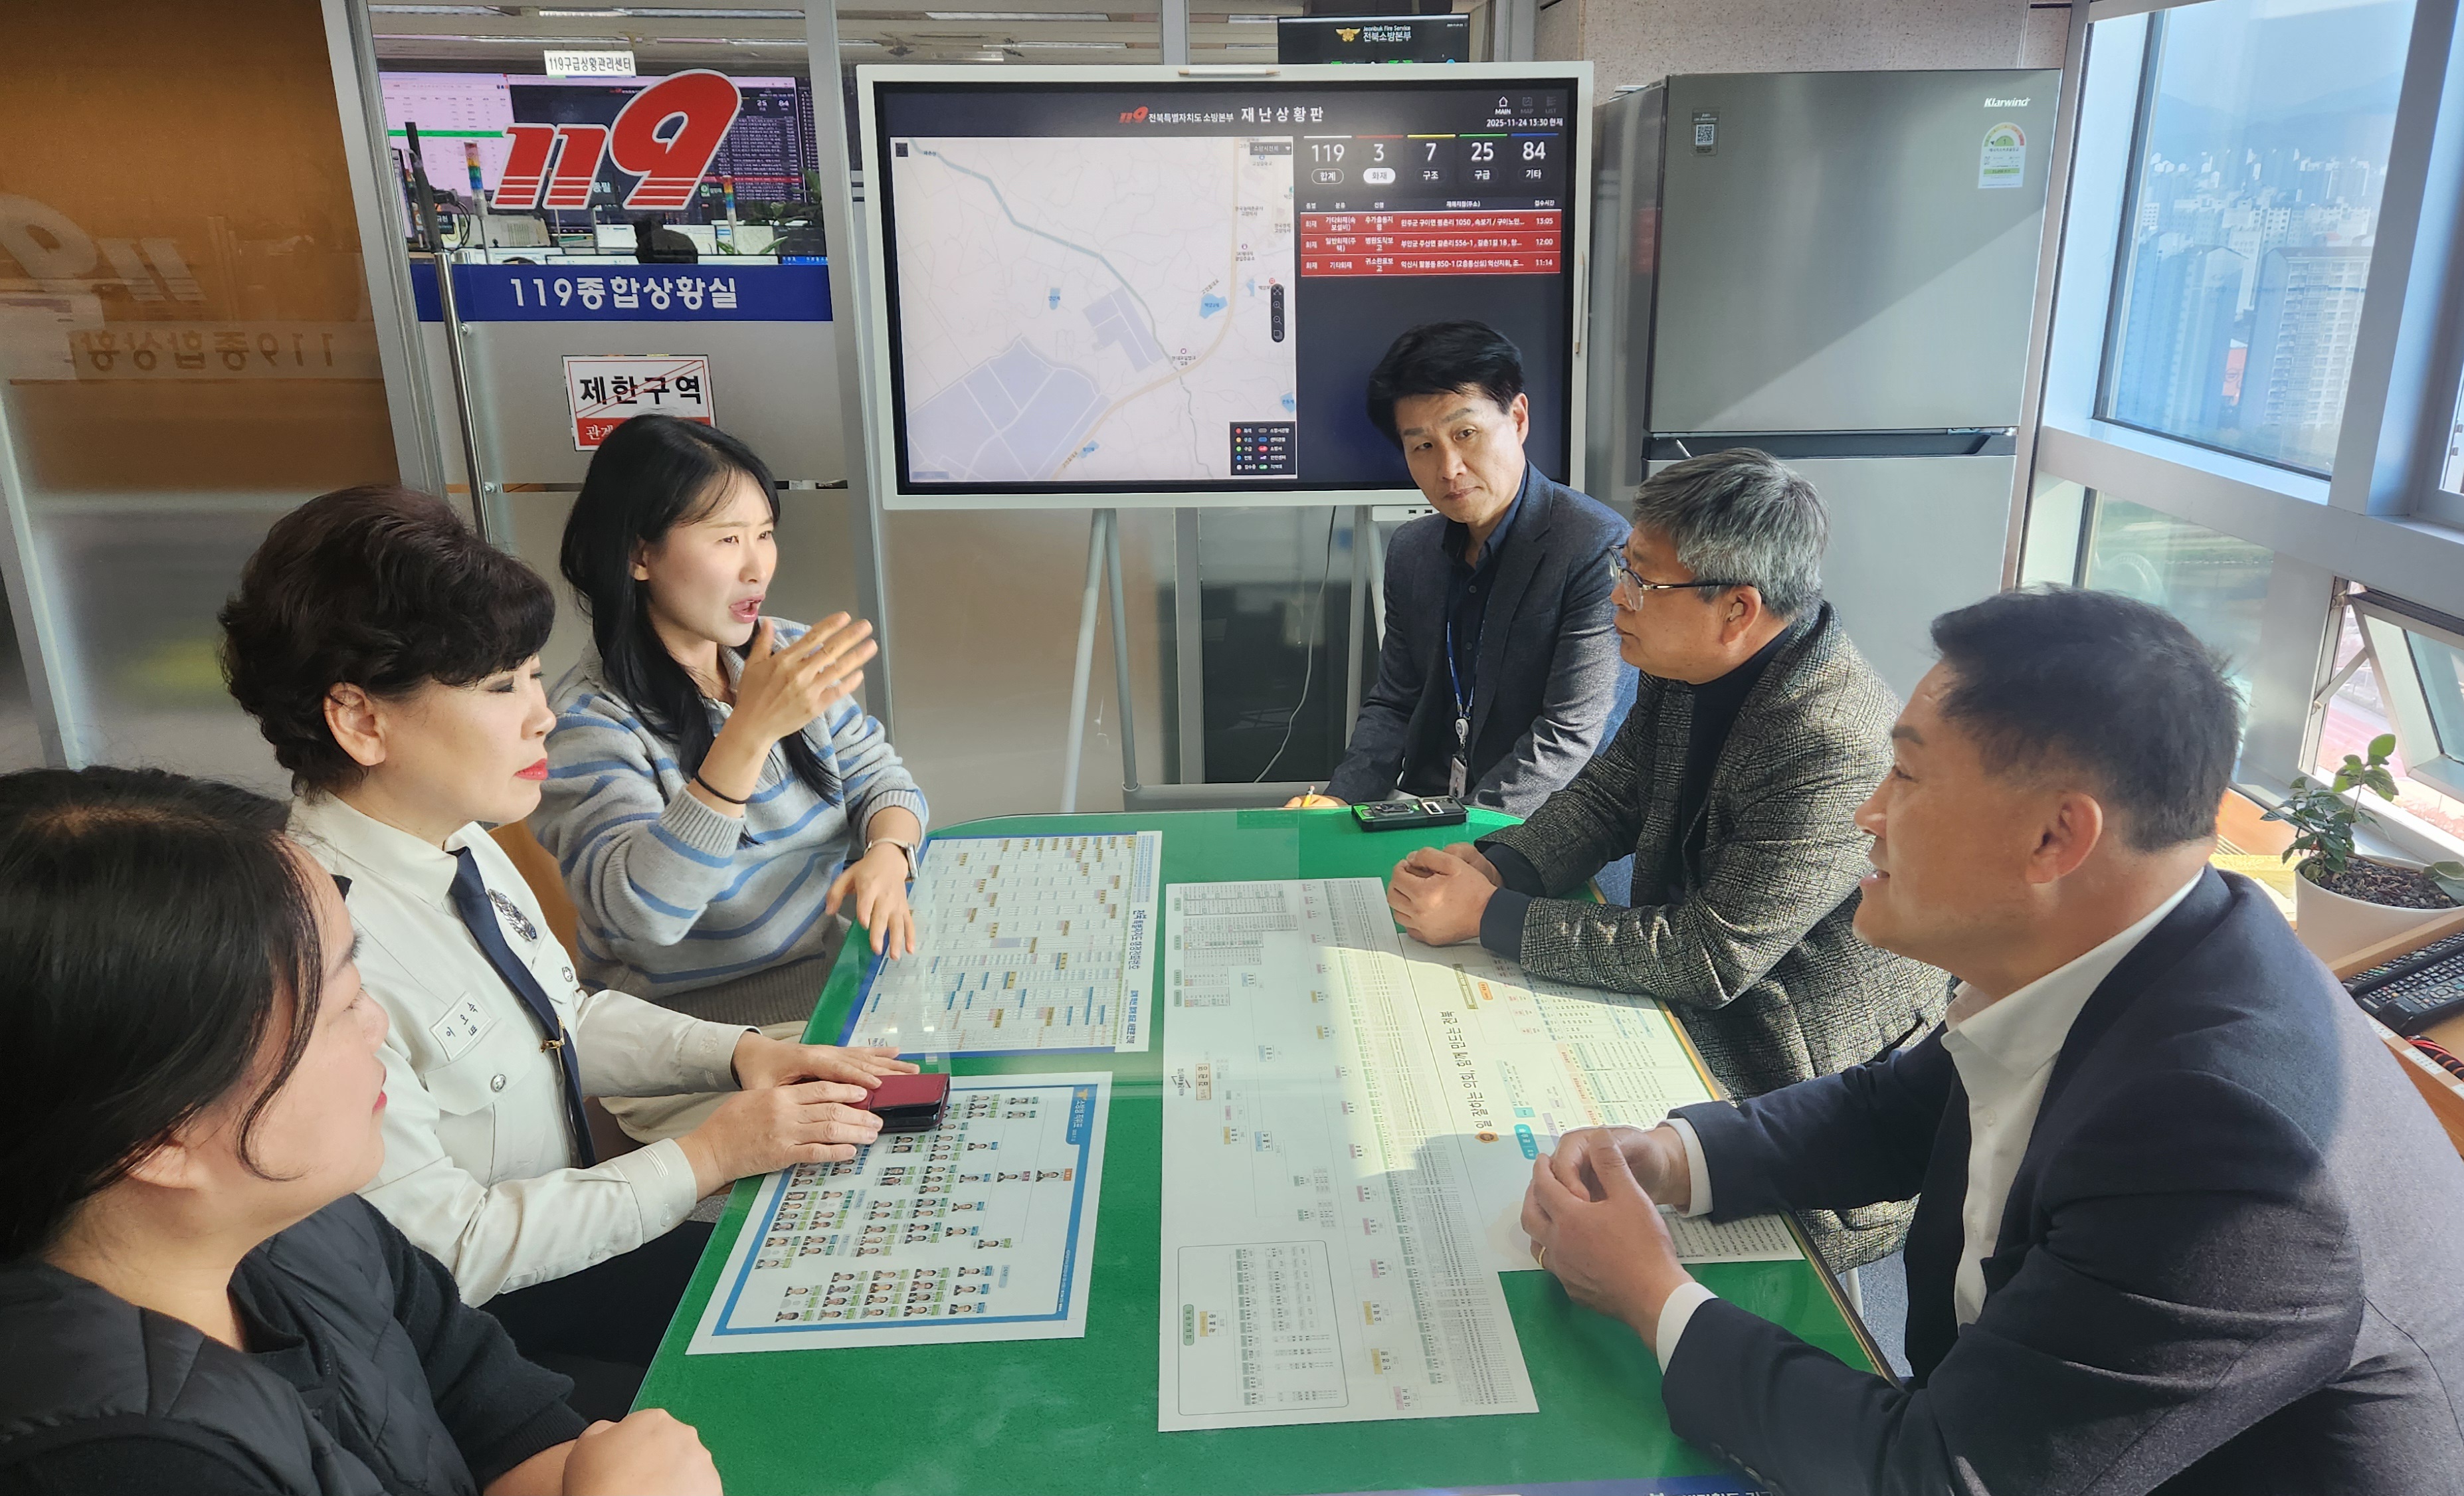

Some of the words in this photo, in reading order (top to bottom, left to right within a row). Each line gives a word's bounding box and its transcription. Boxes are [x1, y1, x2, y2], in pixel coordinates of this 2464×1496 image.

[1363, 31, 1411, 42] 전북소방본부
[549, 55, 631, 72] 119구급상황관리센터
[1119, 106, 1148, 123] 119
[1149, 113, 1202, 122] 전북특별자치도
[1204, 113, 1234, 122] 소방본부
[1486, 118, 1527, 127] 2025-11-24
[1529, 118, 1548, 126] 13:30
[1549, 117, 1563, 127] 현재
[490, 68, 742, 210] 119
[1311, 143, 1345, 161] 119
[1373, 143, 1384, 161] 3
[1425, 143, 1437, 161] 7
[1470, 142, 1494, 161] 25
[1522, 141, 1546, 160] 84
[1320, 171, 1336, 181] 합계
[1371, 170, 1387, 180] 화재
[1423, 169, 1439, 180] 구조
[1474, 169, 1491, 179] 구급
[1525, 168, 1542, 179] 기타
[510, 275, 737, 310] 119종합상황실
[579, 375, 702, 405] 제한구역
[1440, 1011, 1458, 1024] 전북
[1446, 1027, 1466, 1049] 만드는
[1452, 1052, 1471, 1067] 함께
[1459, 1070, 1479, 1088] 의회,
[1467, 1091, 1489, 1117] 잘하는
[1474, 1120, 1493, 1129] 일
